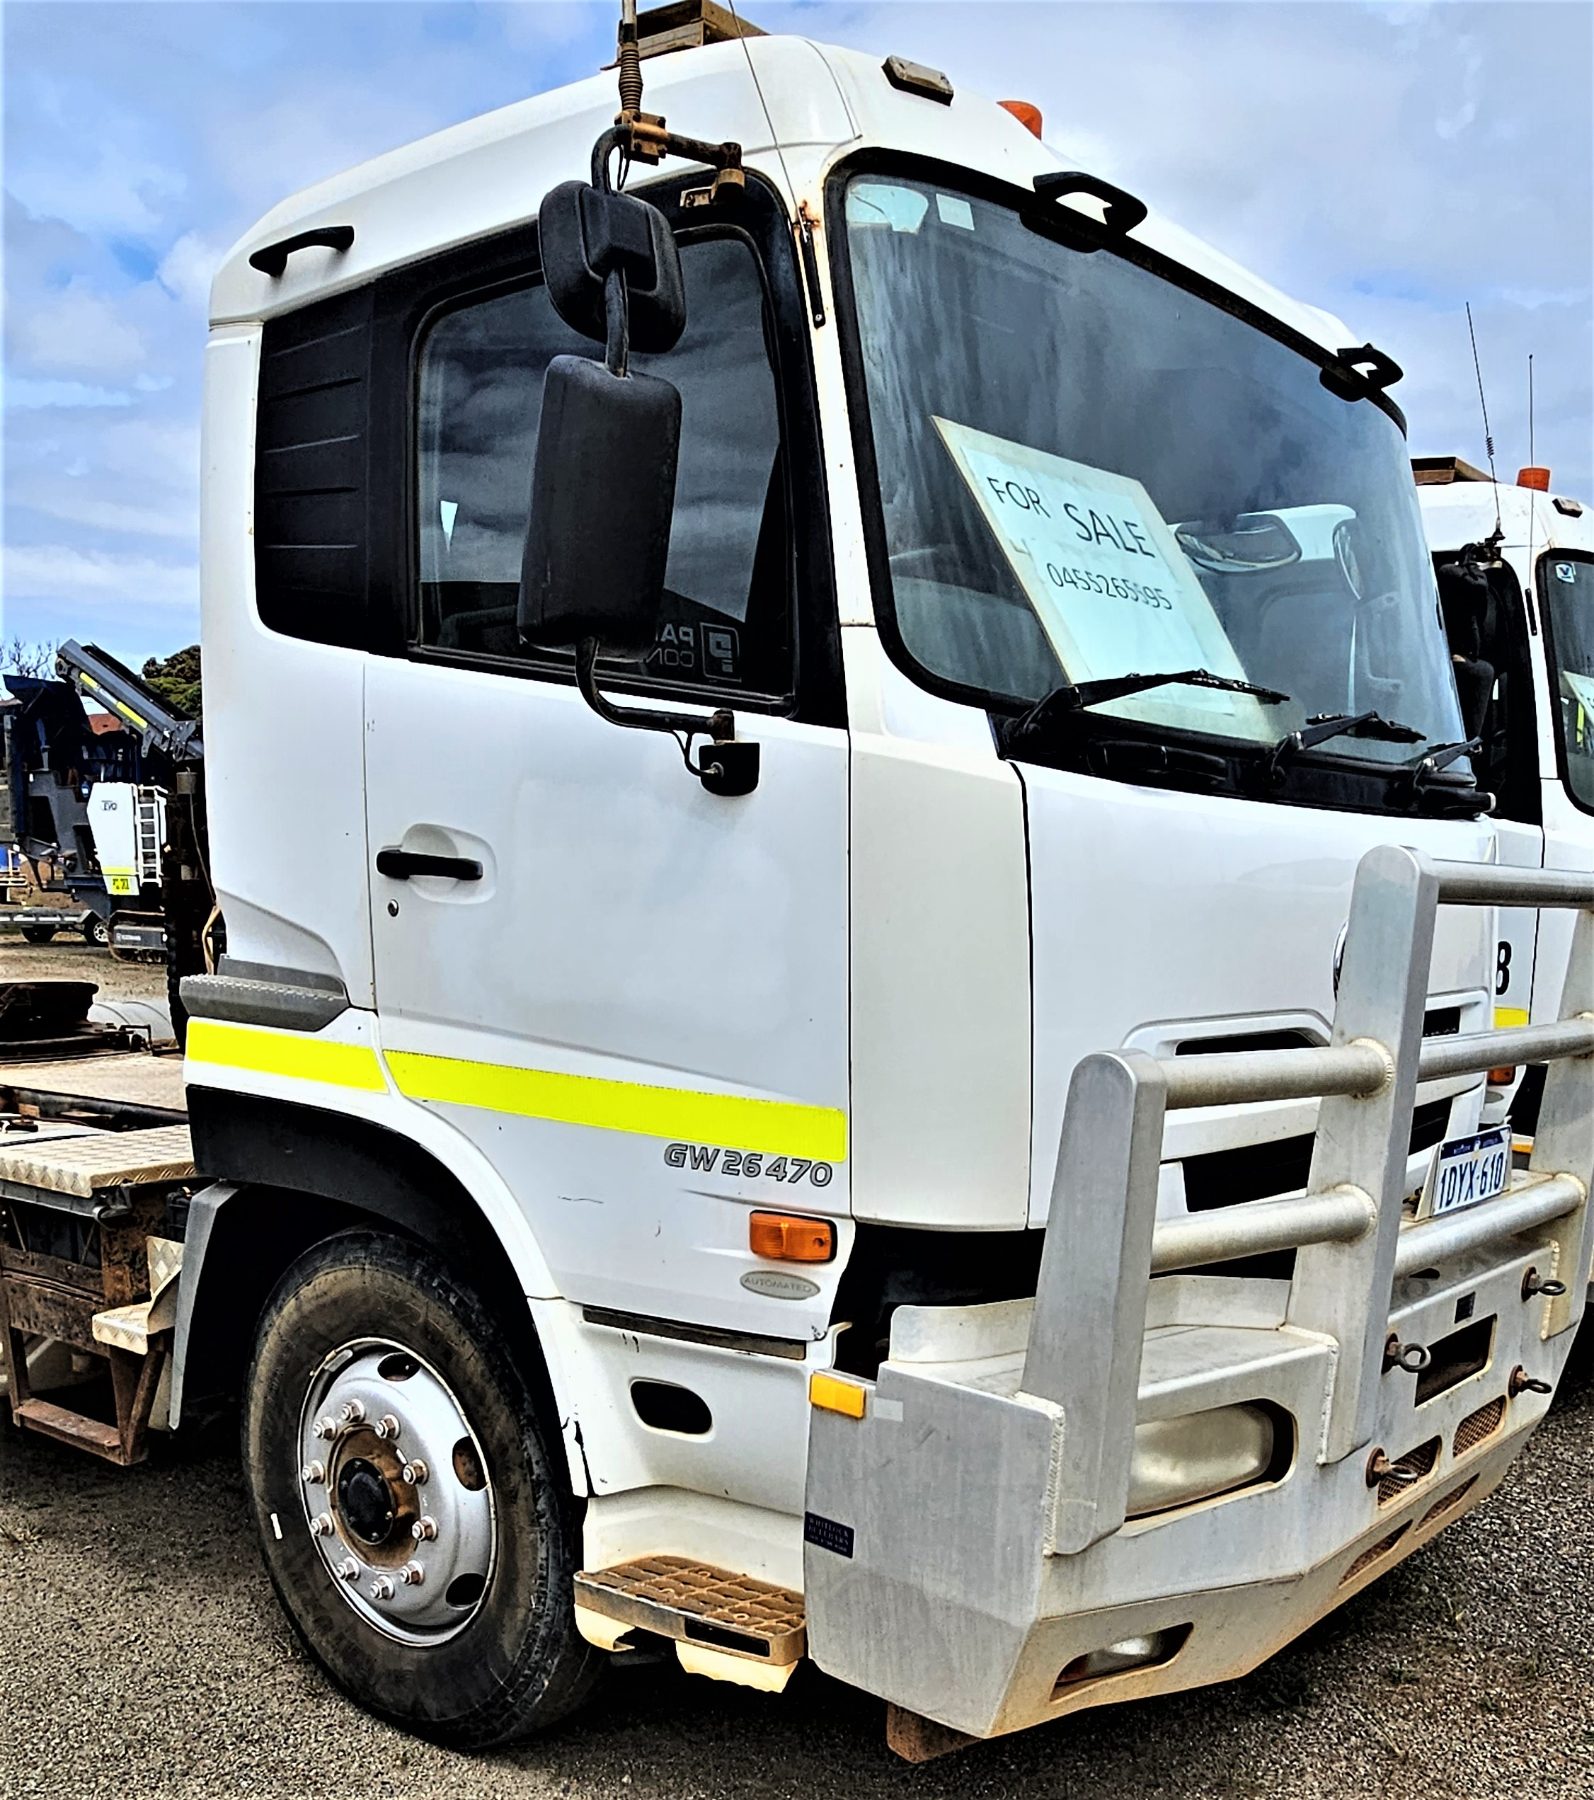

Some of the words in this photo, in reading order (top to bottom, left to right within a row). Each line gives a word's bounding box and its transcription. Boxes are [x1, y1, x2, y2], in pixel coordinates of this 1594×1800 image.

[987, 476, 1051, 518] FOR
[1063, 503, 1155, 558] SALE
[744, 1276, 813, 1293] AUTOMATED
